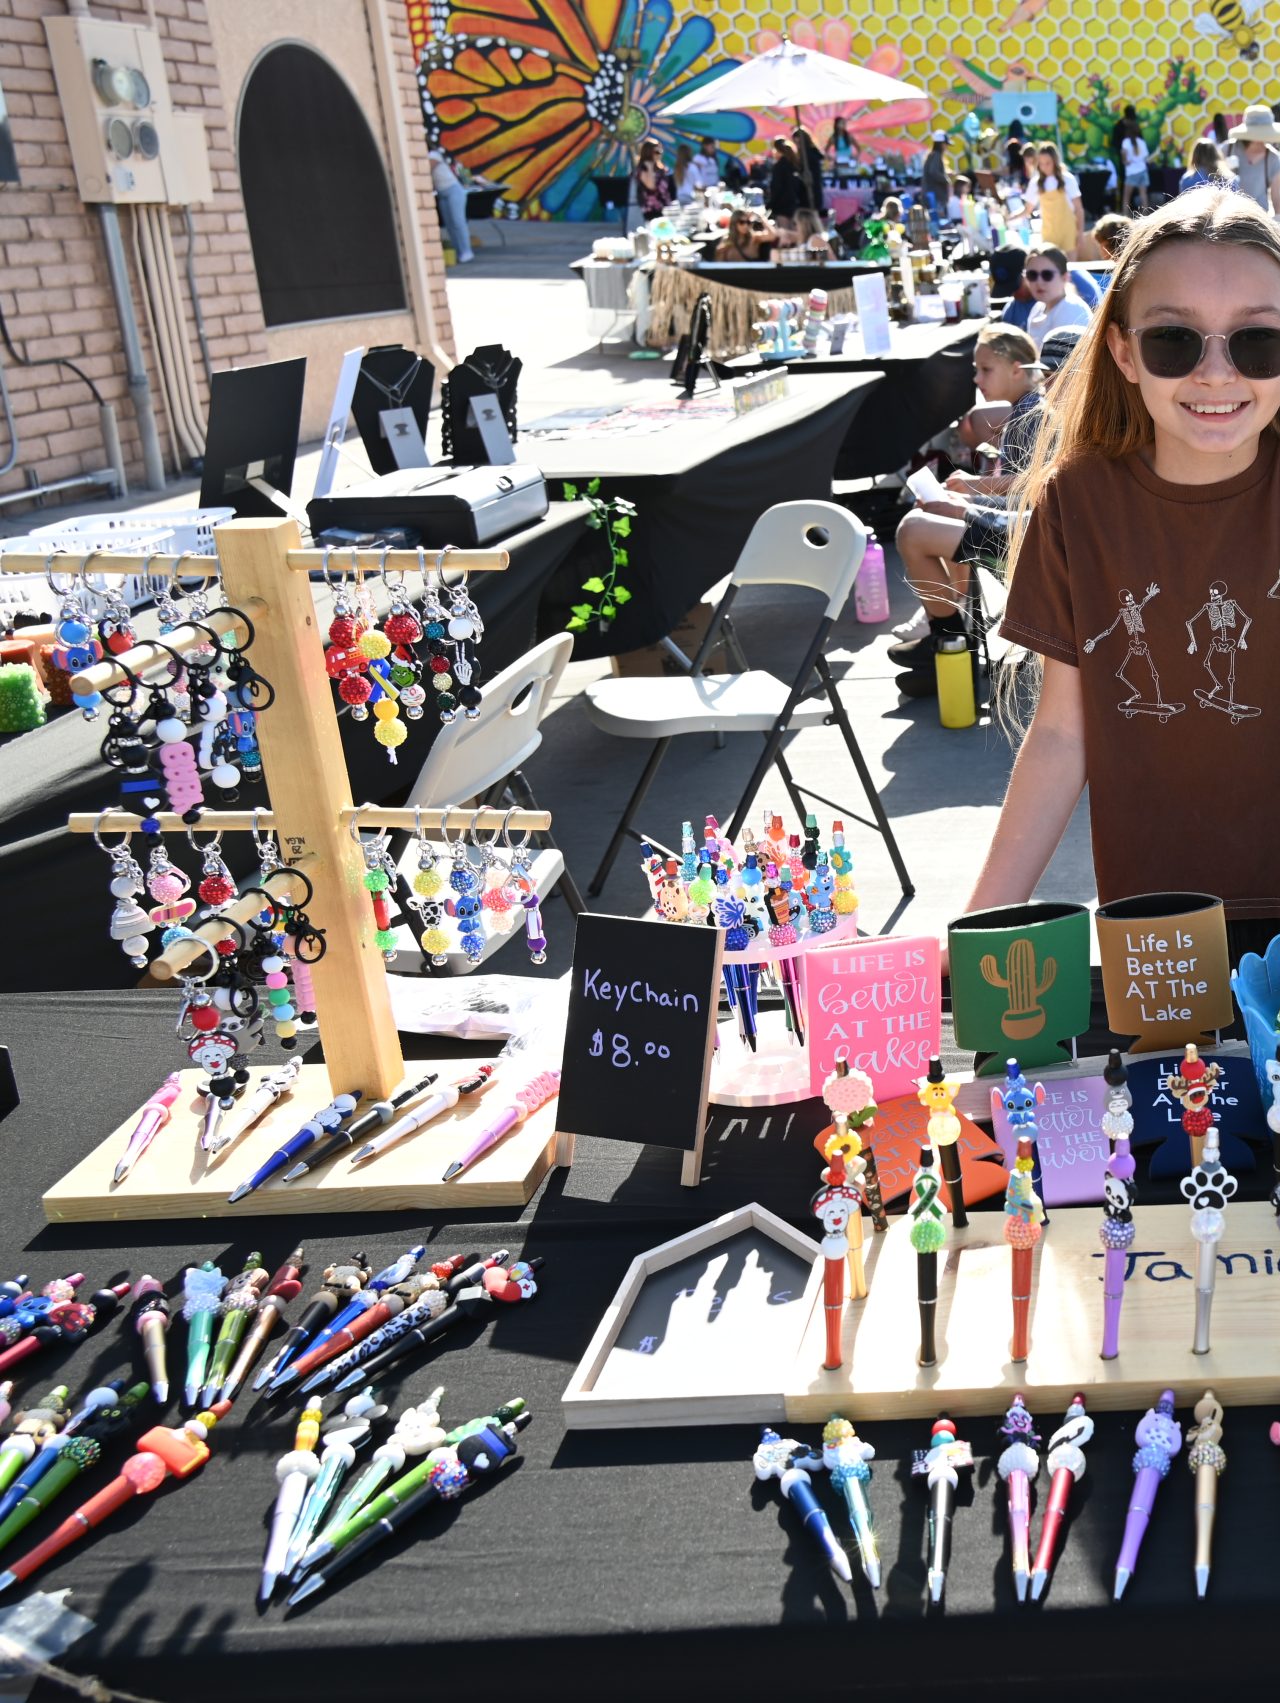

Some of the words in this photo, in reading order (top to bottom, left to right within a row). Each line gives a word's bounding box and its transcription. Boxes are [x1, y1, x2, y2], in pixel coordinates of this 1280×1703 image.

[1126, 933, 1168, 953] Life
[1176, 930, 1193, 949] Is
[832, 953, 895, 975] LIFE
[905, 948, 926, 968] IS
[1126, 957, 1198, 976] Better
[818, 971, 935, 1014] better
[1126, 981, 1159, 999] AT
[1166, 979, 1208, 998] The
[1141, 1003, 1192, 1022] Lake
[824, 1020, 868, 1040] AT
[881, 1010, 931, 1035] THE
[1071, 1090, 1088, 1103] IS
[1039, 1105, 1102, 1132] etter
[1061, 1131, 1103, 1146] THE
